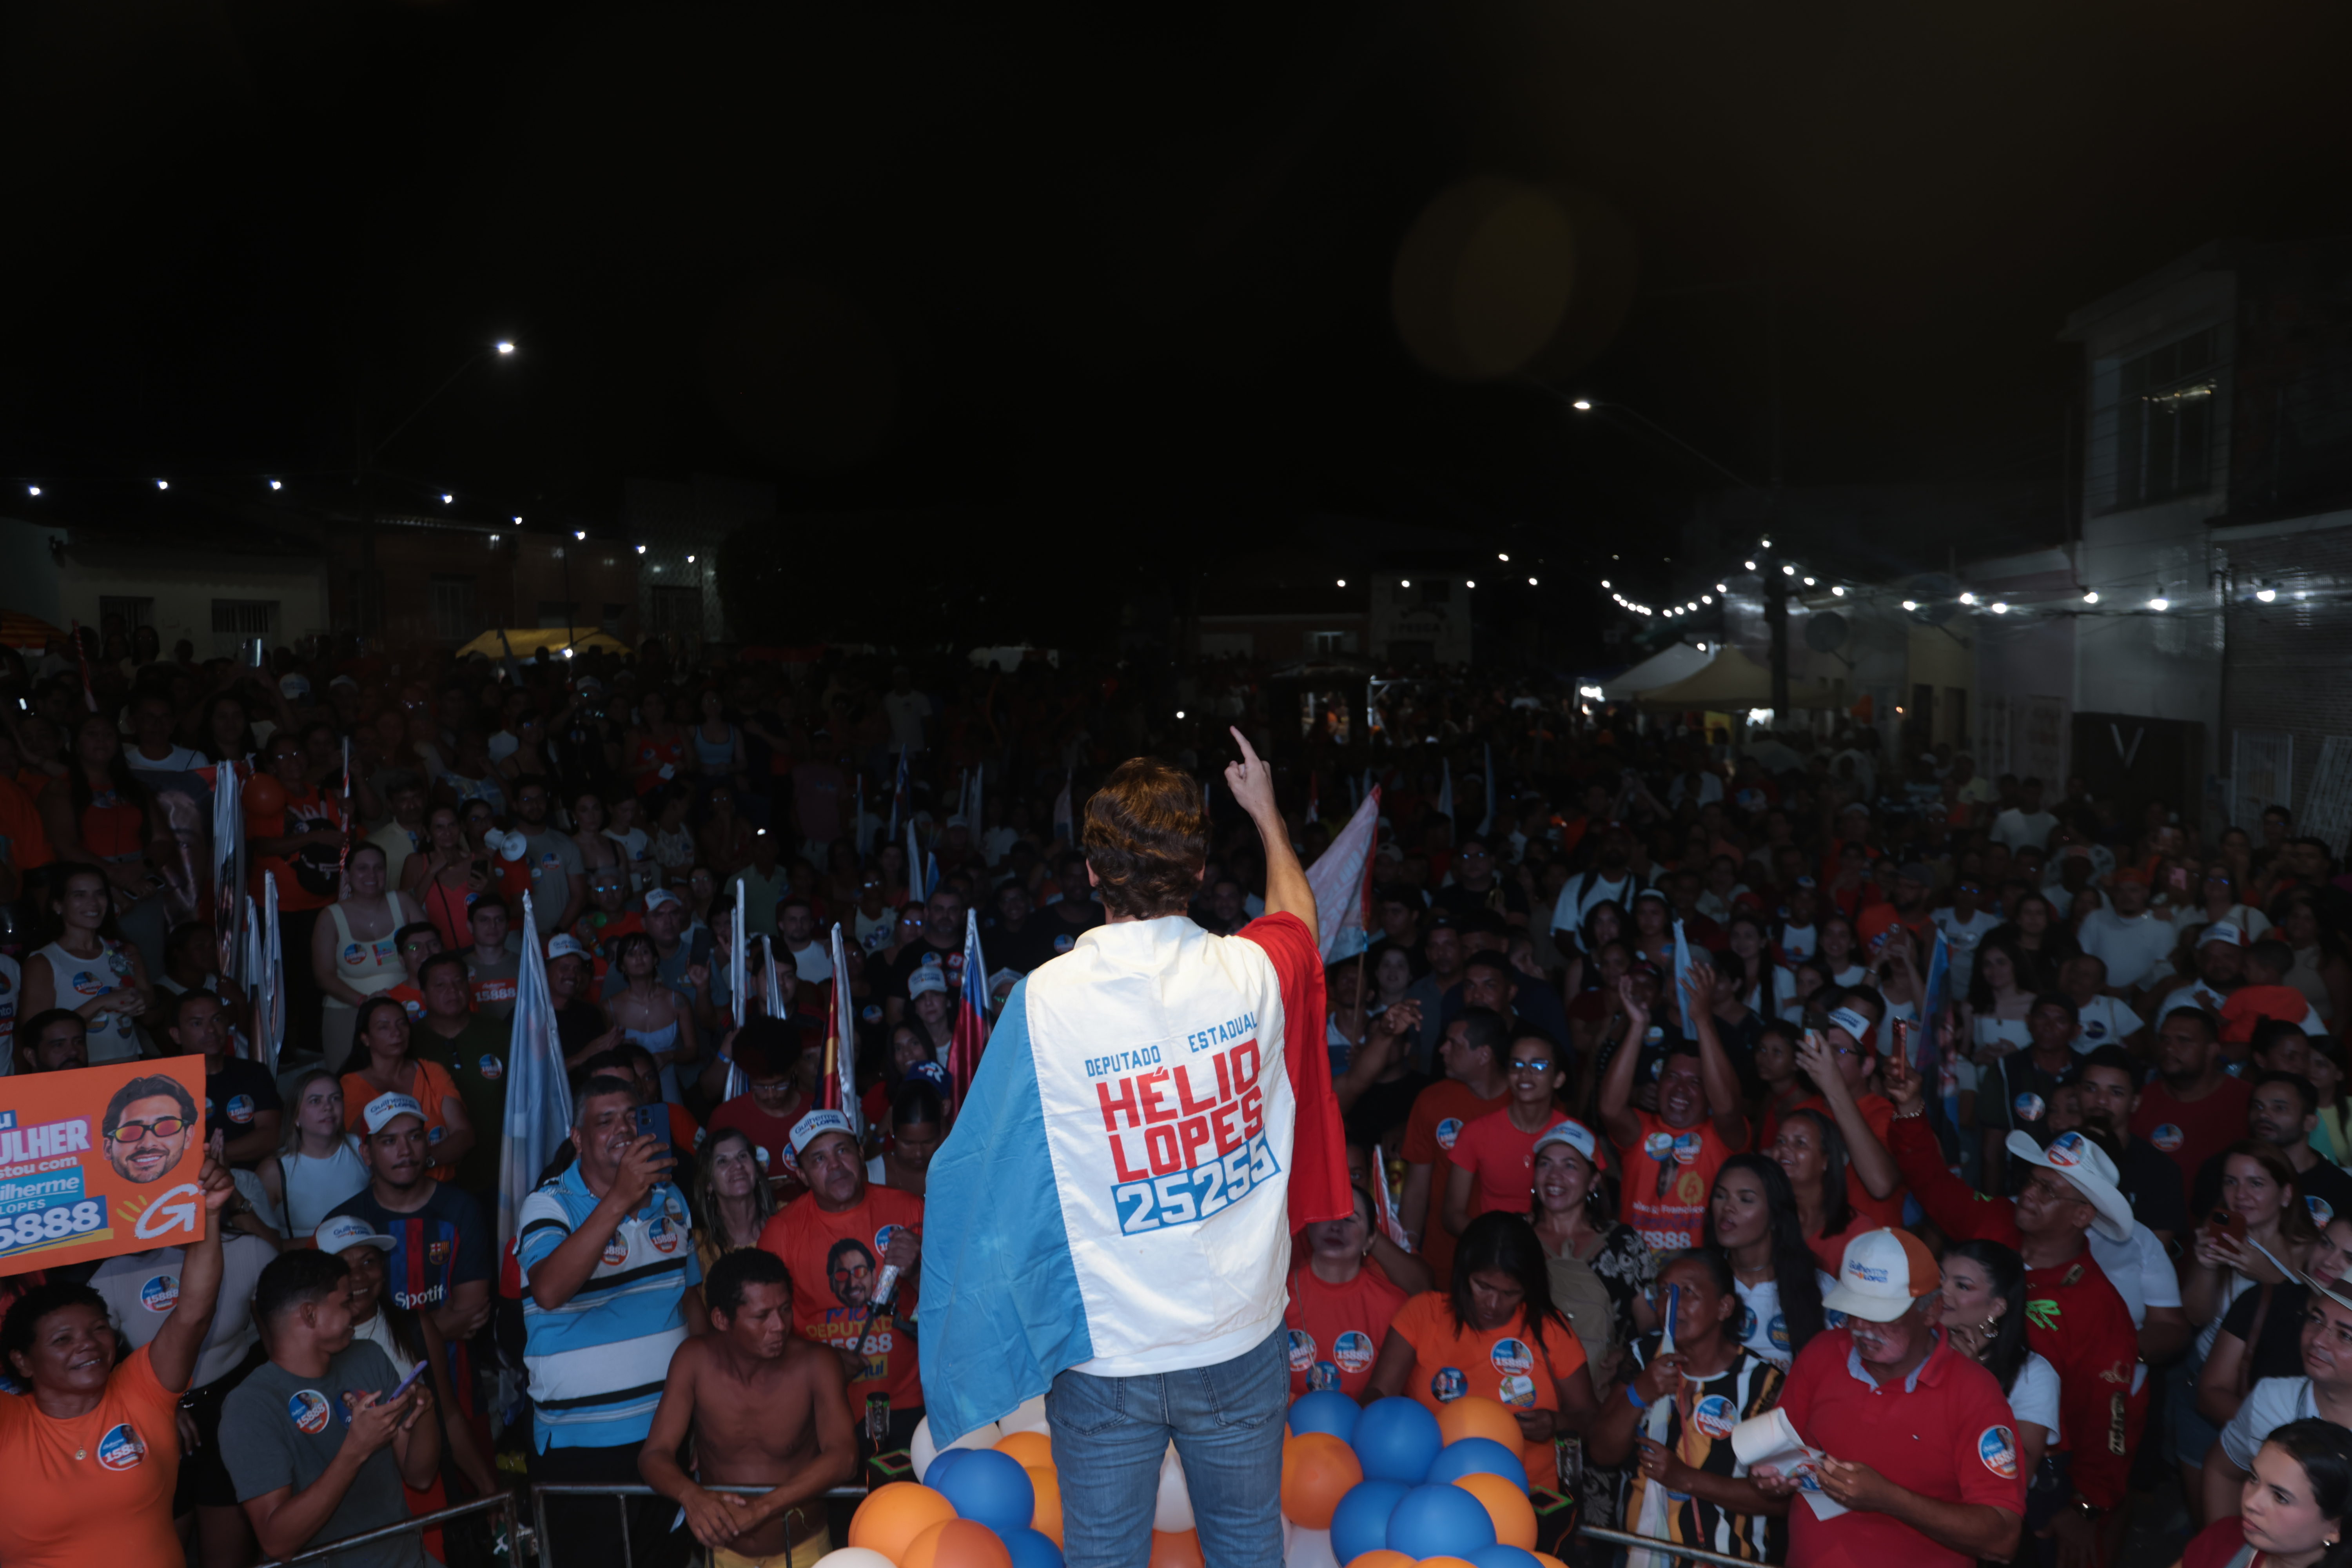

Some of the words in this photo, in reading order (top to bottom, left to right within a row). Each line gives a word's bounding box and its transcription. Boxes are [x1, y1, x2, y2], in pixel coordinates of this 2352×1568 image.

[475, 987, 516, 1002] 15888
[1085, 1045, 1161, 1077] DEPUTADO
[1187, 1012, 1257, 1053] ESTADUAL
[1096, 1038, 1261, 1132] HÉLIO
[795, 1112, 839, 1134] Guilherme
[1108, 1085, 1263, 1183] LOPES
[38, 1156, 78, 1171] com
[1116, 1127, 1276, 1233] 25255
[0, 1199, 46, 1214] LOPES
[1636, 1229, 1693, 1250] 5888
[395, 1283, 448, 1310] Spotif
[806, 1314, 903, 1338] DEPUTAD
[822, 1333, 893, 1355] 888
[296, 1403, 325, 1428] 15888
[105, 1443, 144, 1463] 15888
